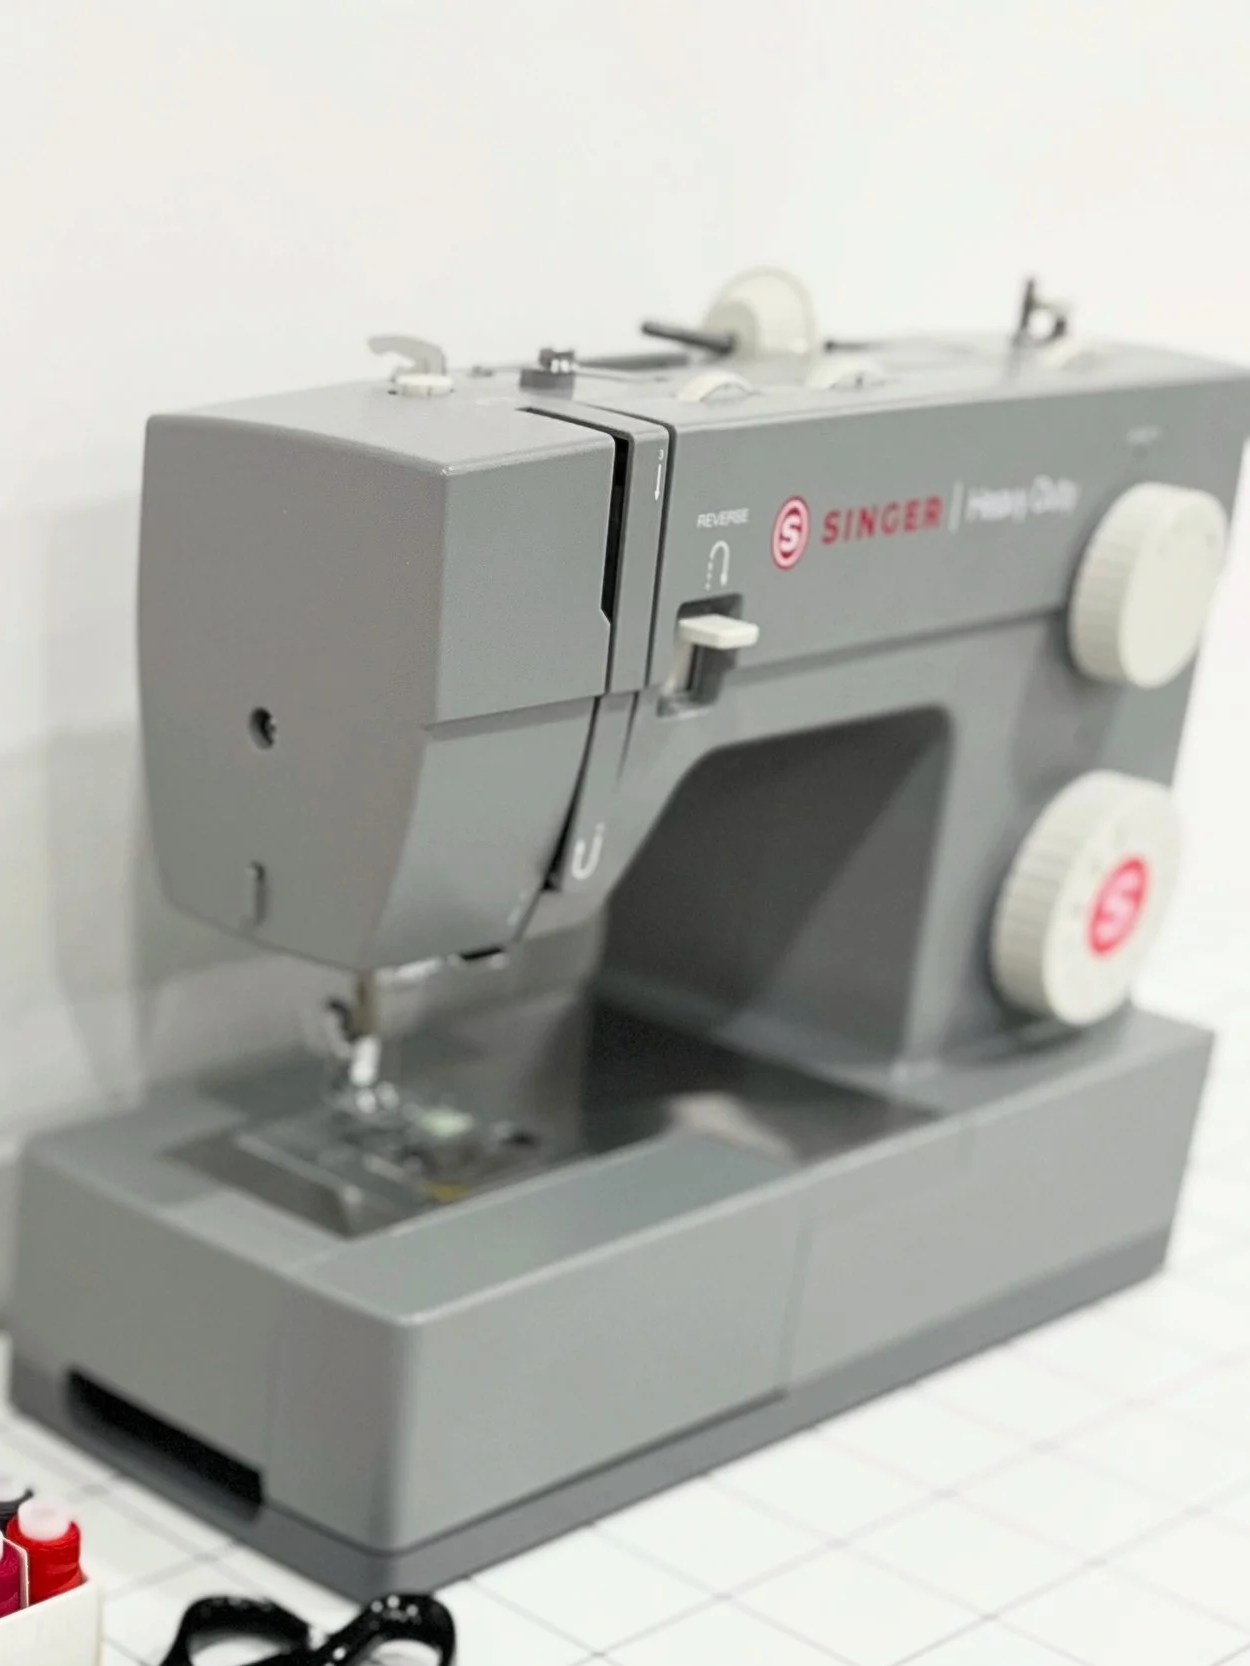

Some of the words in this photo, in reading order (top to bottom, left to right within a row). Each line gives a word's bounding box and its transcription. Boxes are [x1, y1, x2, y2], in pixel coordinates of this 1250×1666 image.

[658, 448, 665, 461] 3
[696, 507, 750, 529] REVERSE
[821, 497, 944, 545] SINGER
